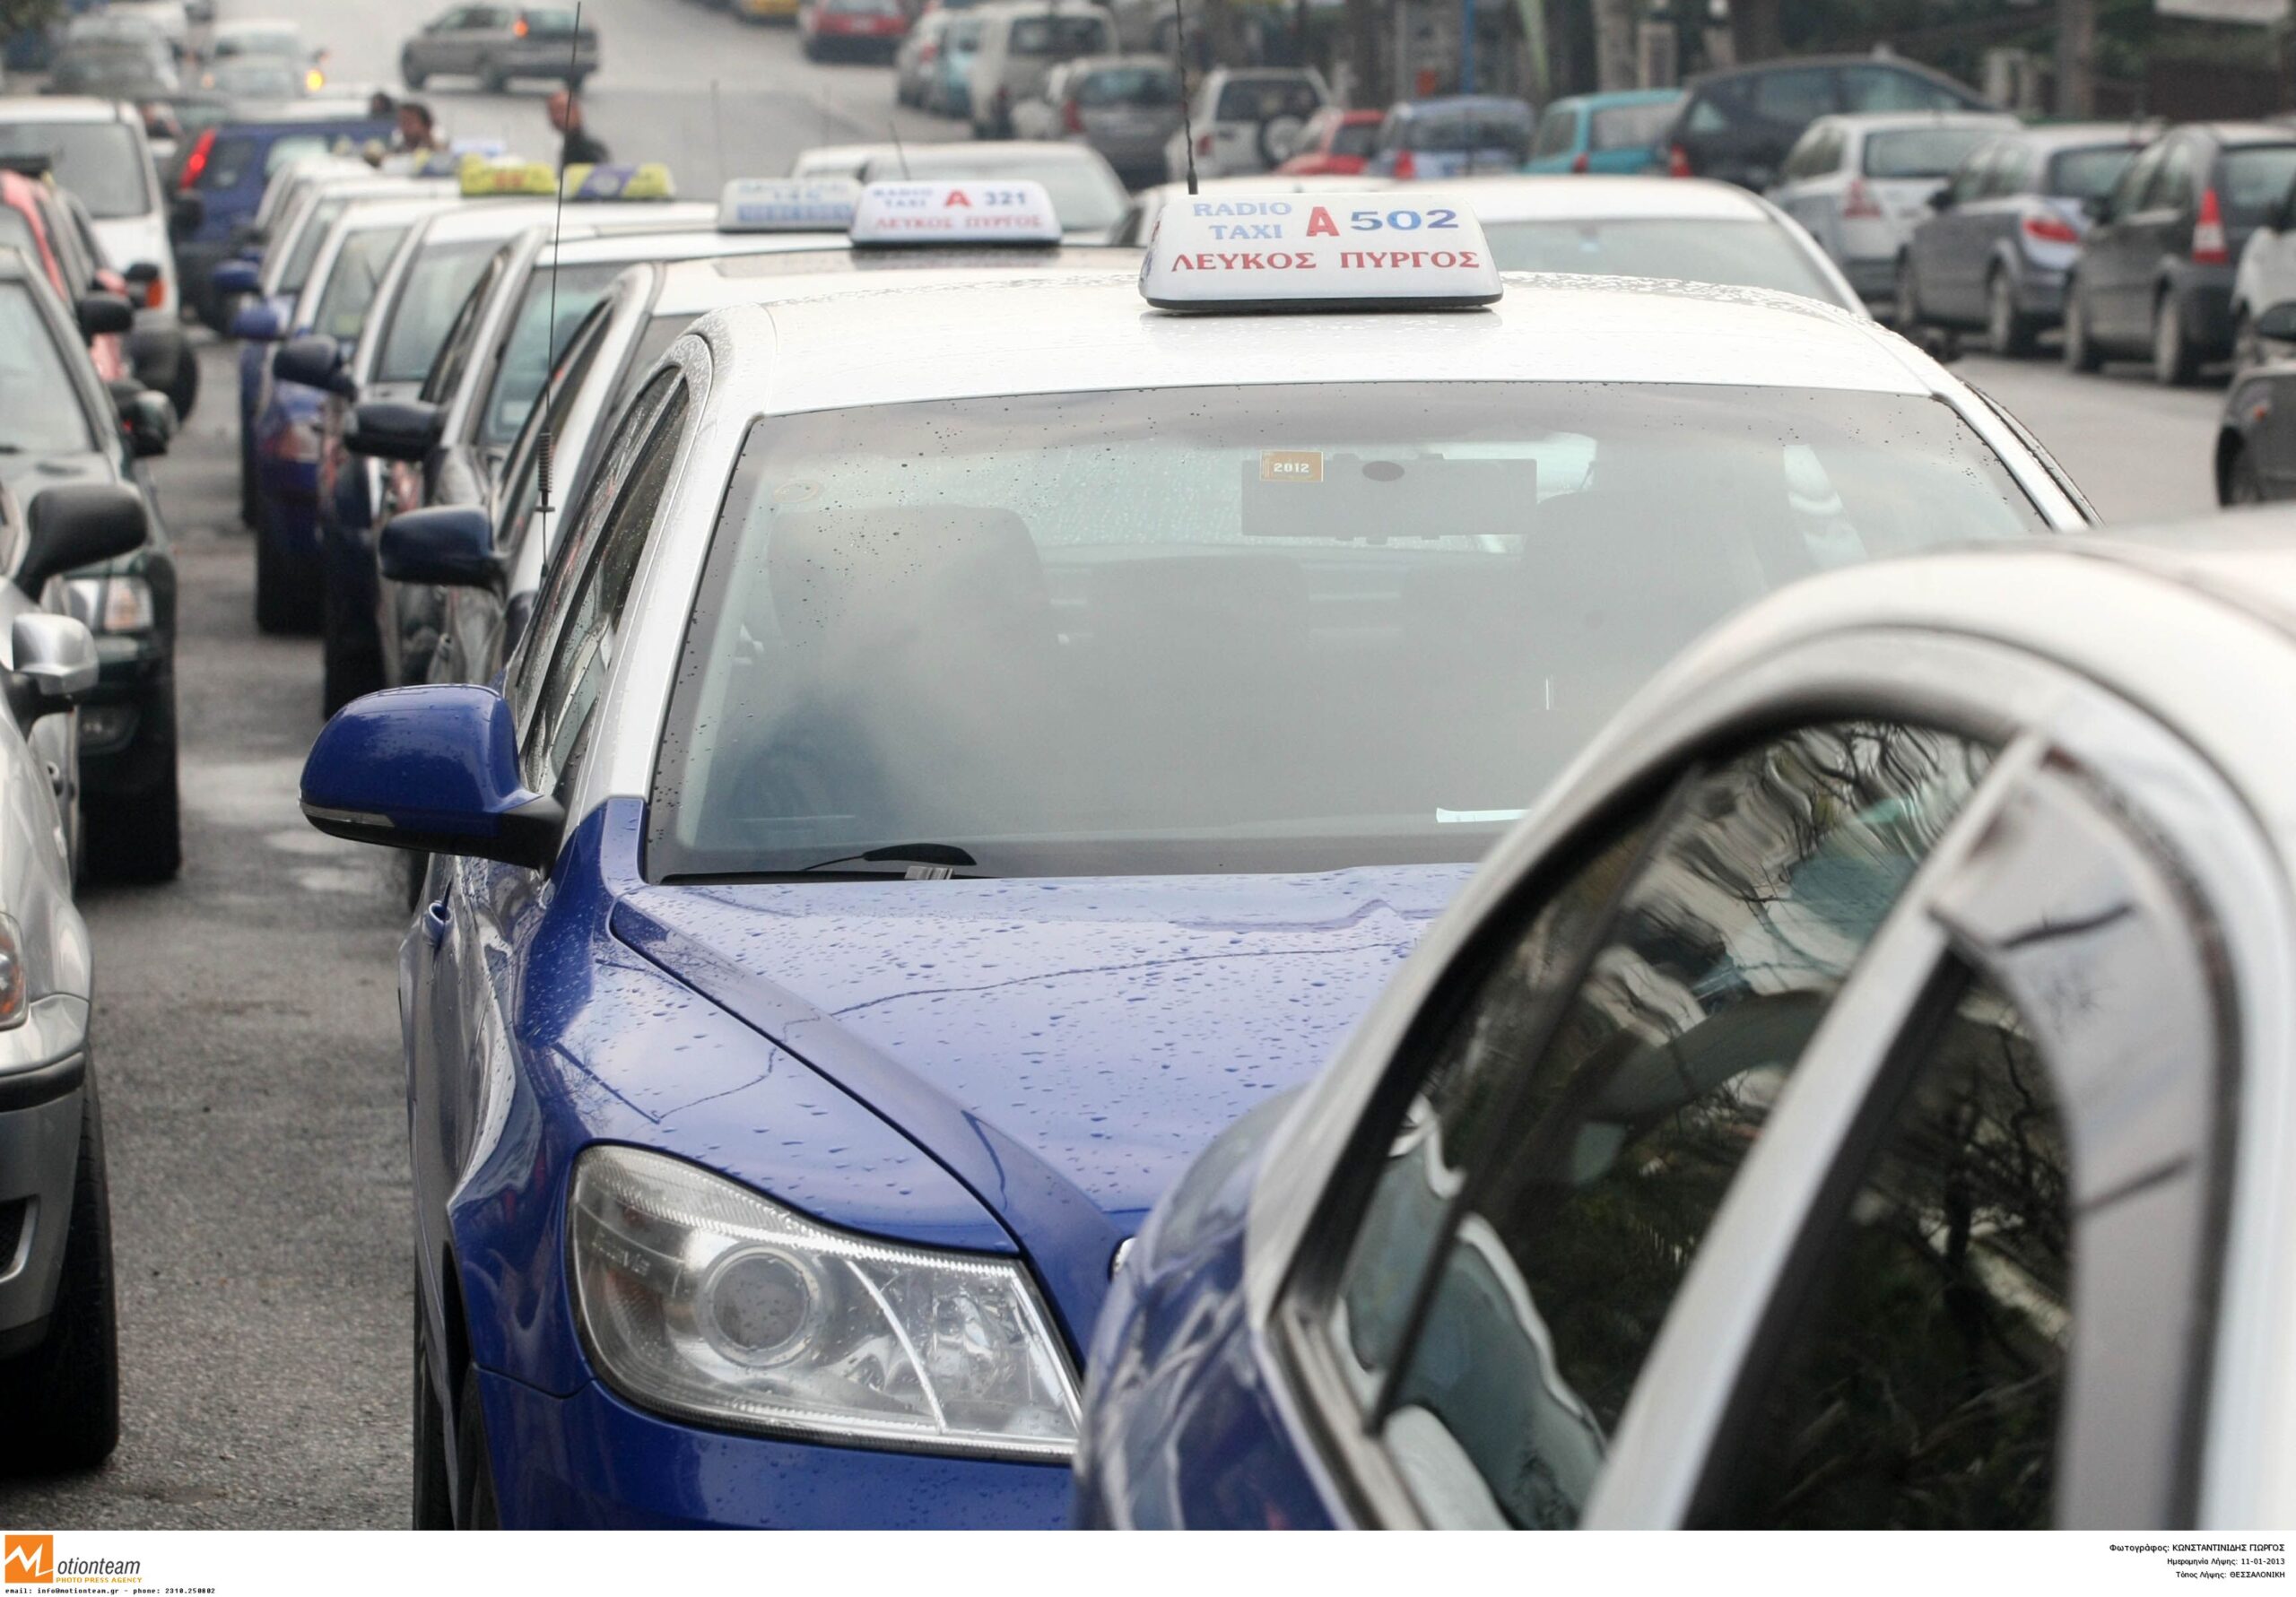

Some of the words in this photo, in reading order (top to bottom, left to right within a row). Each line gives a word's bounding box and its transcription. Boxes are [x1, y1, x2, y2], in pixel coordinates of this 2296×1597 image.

[944, 189, 971, 209] A
[986, 190, 1025, 206] 321
[1193, 202, 1292, 216] RADIO
[1306, 206, 1340, 237] A
[1351, 209, 1459, 231] 502
[1208, 224, 1283, 239] TAXI
[1171, 252, 1317, 272] ΛΕΥΚΟΣ
[1340, 251, 1480, 269] ΠΥΡΓΟΣ
[1274, 463, 1309, 473] 2012
